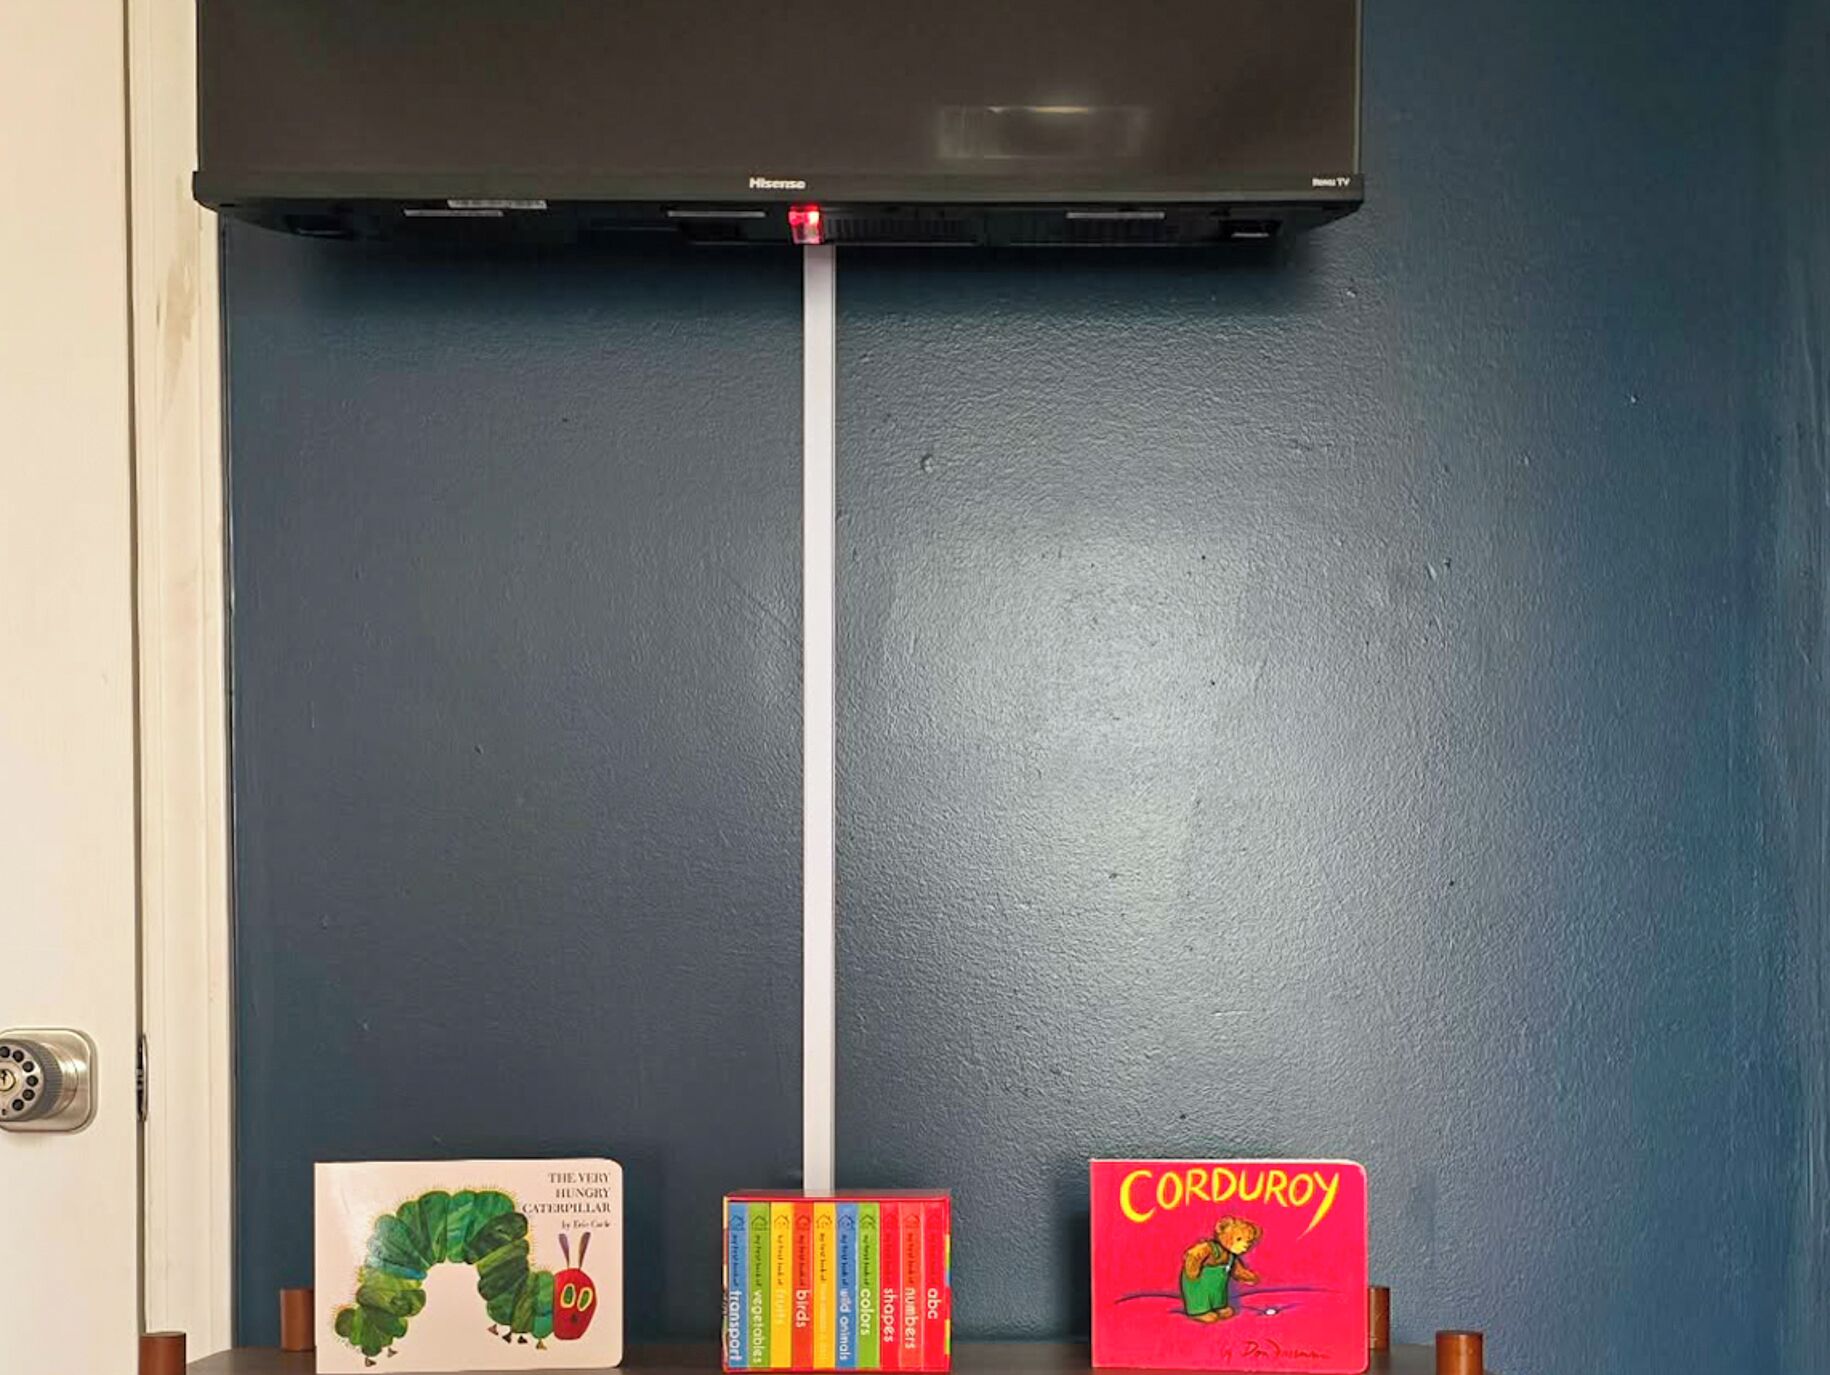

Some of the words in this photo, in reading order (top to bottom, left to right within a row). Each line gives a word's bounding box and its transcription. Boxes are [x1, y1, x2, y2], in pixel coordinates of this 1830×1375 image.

[548, 1172, 577, 1184] THE
[577, 1172, 611, 1184] VERY
[555, 1187, 611, 1199] HUNGRY
[522, 1203, 611, 1214] CATERPILLAR
[1119, 1166, 1340, 1241] CORDUROY
[795, 1289, 810, 1329] birds
[839, 1288, 851, 1313] wild
[860, 1288, 875, 1336] colors
[881, 1287, 898, 1342] shapes
[904, 1287, 919, 1349] numbers
[927, 1287, 942, 1320] abc
[728, 1290, 742, 1361] transport
[751, 1290, 765, 1363] vegetables
[839, 1316, 851, 1361] animals
